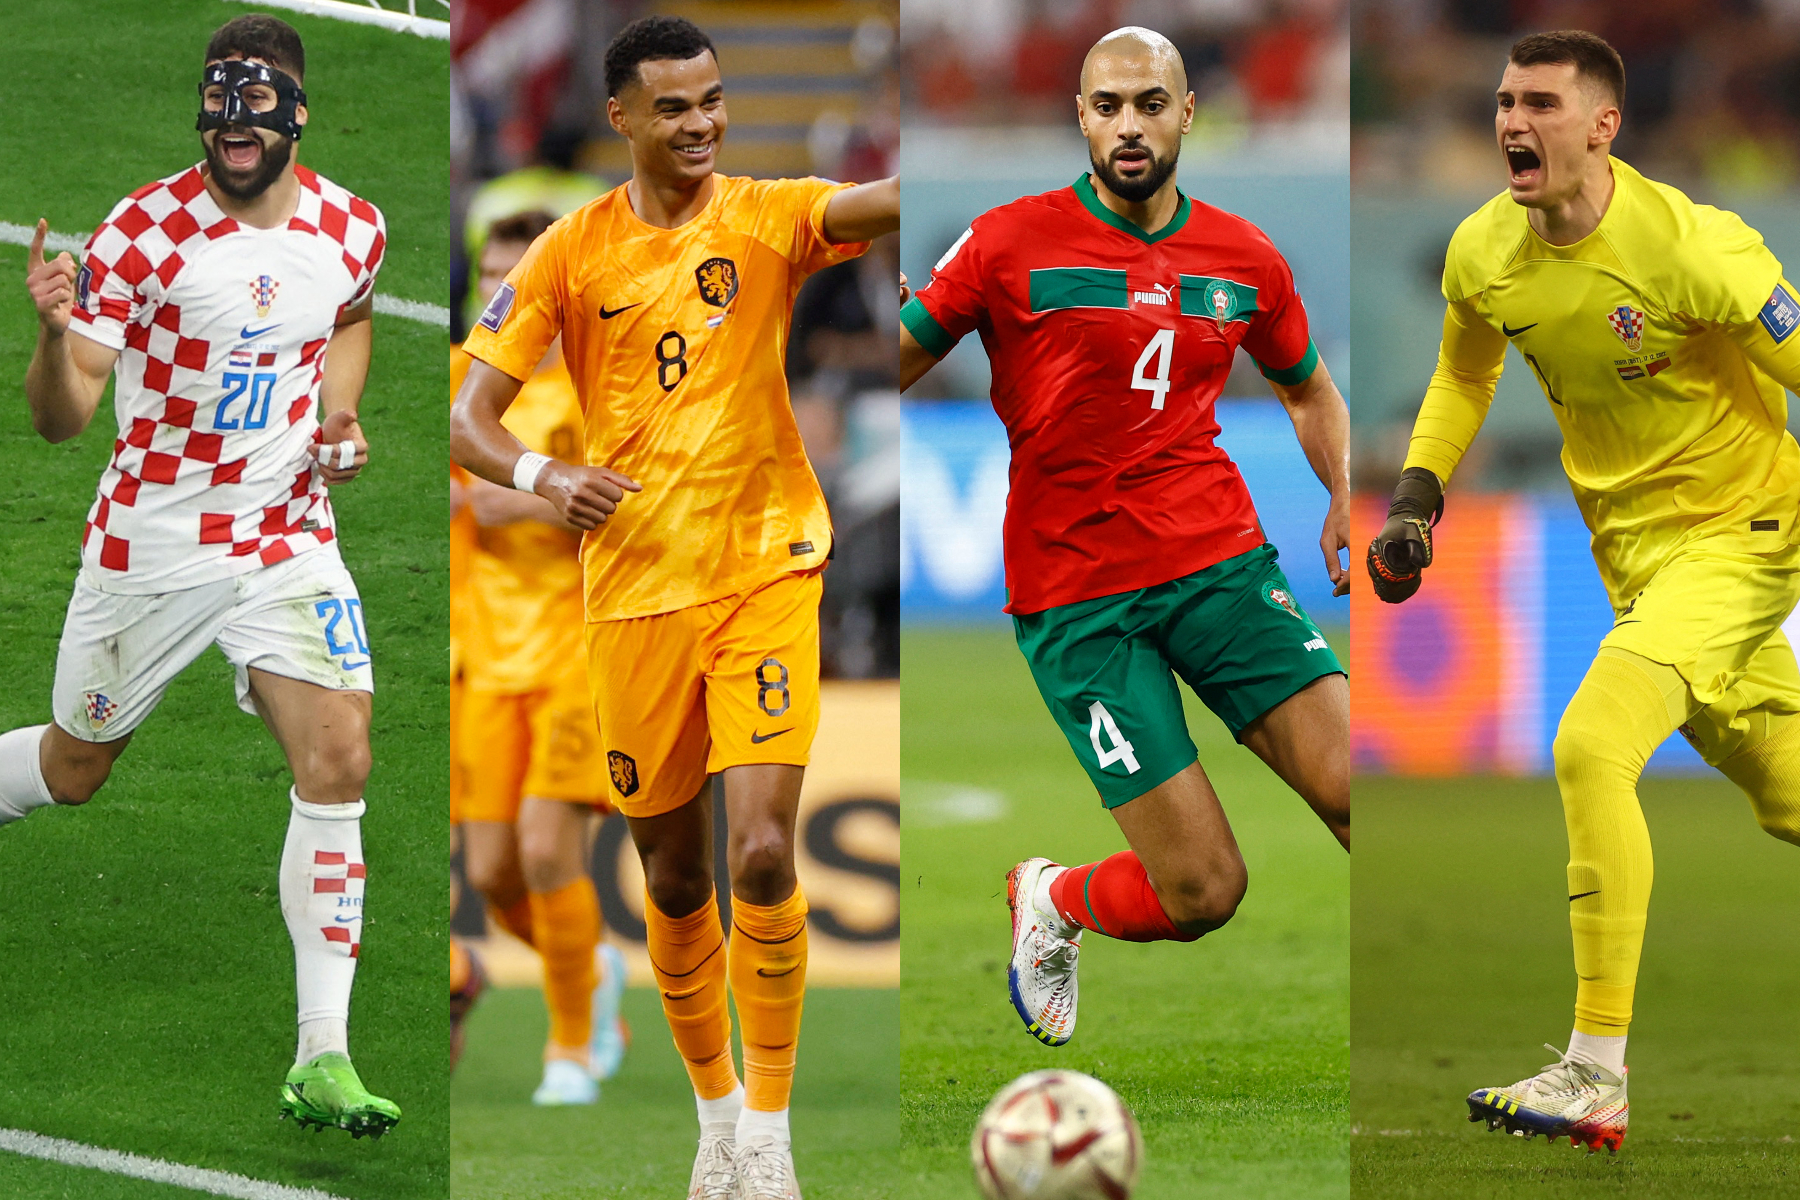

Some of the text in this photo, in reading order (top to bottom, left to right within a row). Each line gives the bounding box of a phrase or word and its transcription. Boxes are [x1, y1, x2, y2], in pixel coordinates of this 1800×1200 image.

[1134, 291, 1167, 306] PUMA
[655, 330, 687, 393] 8
[1131, 329, 1175, 411] 4
[213, 372, 278, 430] 20
[756, 658, 790, 717] 8
[1088, 701, 1141, 774] 4
